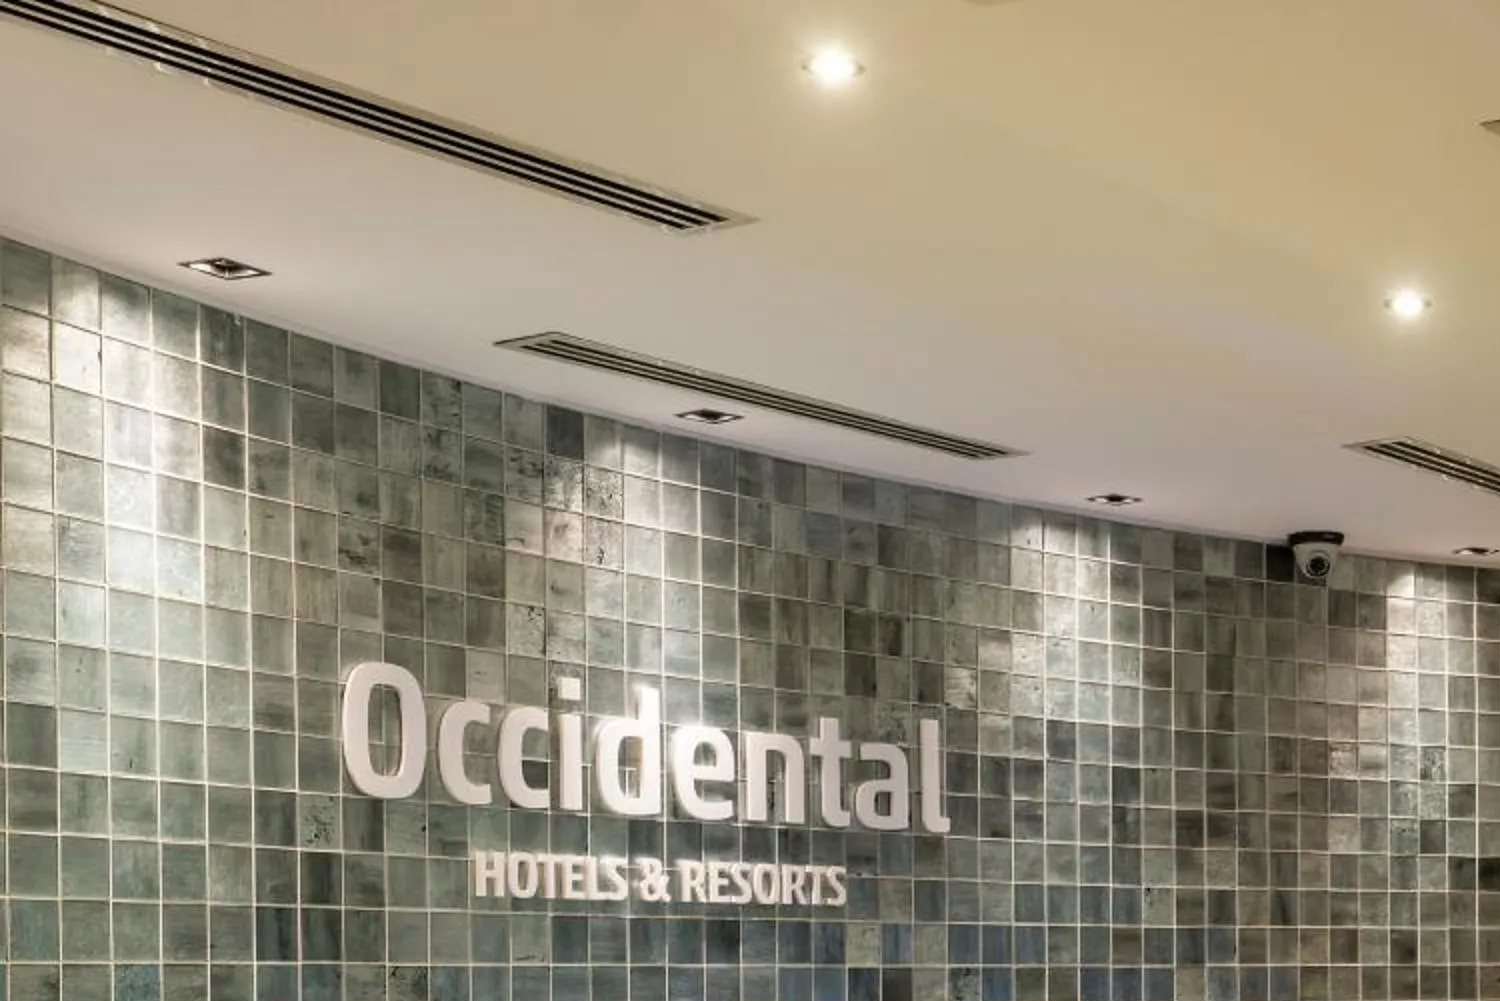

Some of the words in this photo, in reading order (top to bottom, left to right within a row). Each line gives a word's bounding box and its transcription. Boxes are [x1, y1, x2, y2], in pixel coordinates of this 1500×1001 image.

[342, 661, 951, 834] Occidental
[473, 849, 629, 901] HOTELS
[635, 857, 673, 902] &
[680, 858, 847, 907] RESORTS
